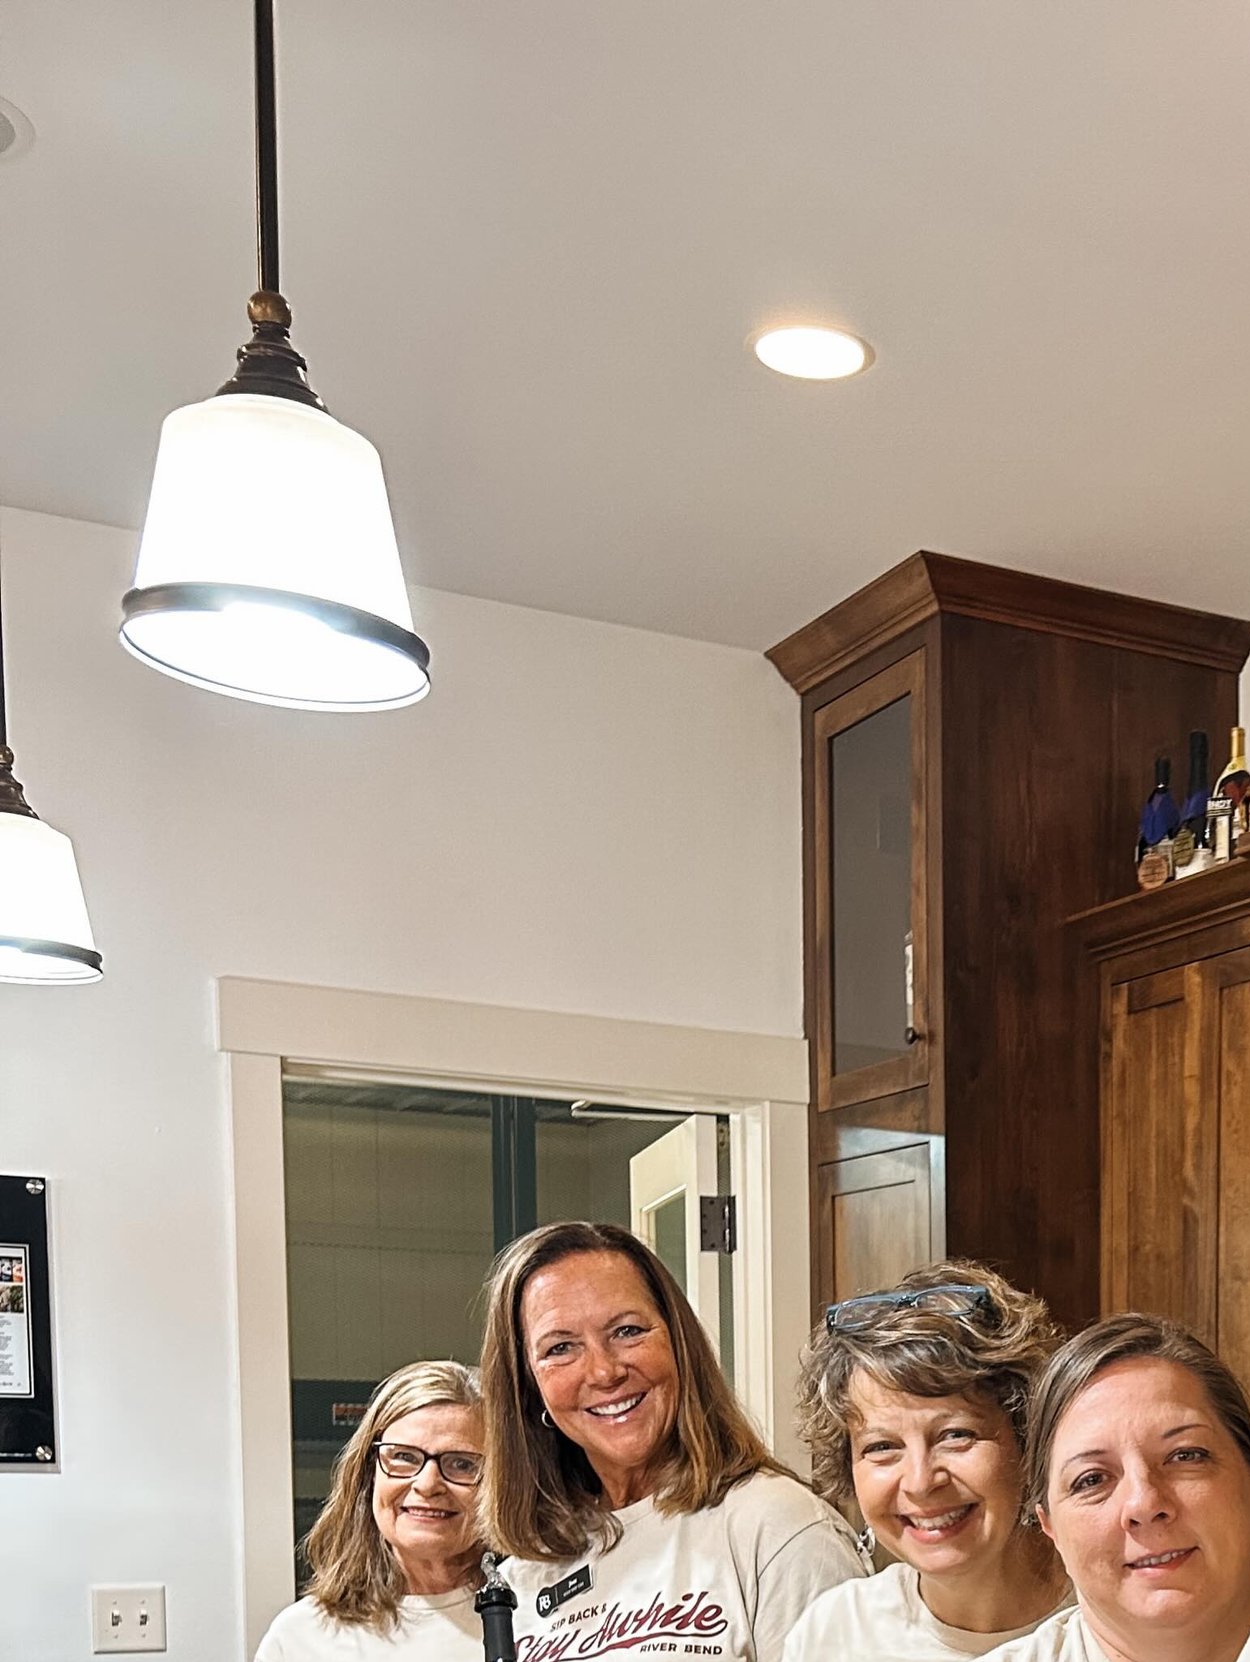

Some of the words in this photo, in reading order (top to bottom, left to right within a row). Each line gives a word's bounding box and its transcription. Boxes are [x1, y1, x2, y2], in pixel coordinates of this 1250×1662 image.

[568, 1605, 600, 1626] BACK
[578, 1591, 728, 1654] Awhile
[640, 1642, 677, 1654] RIVER
[684, 1644, 723, 1656] BEND
